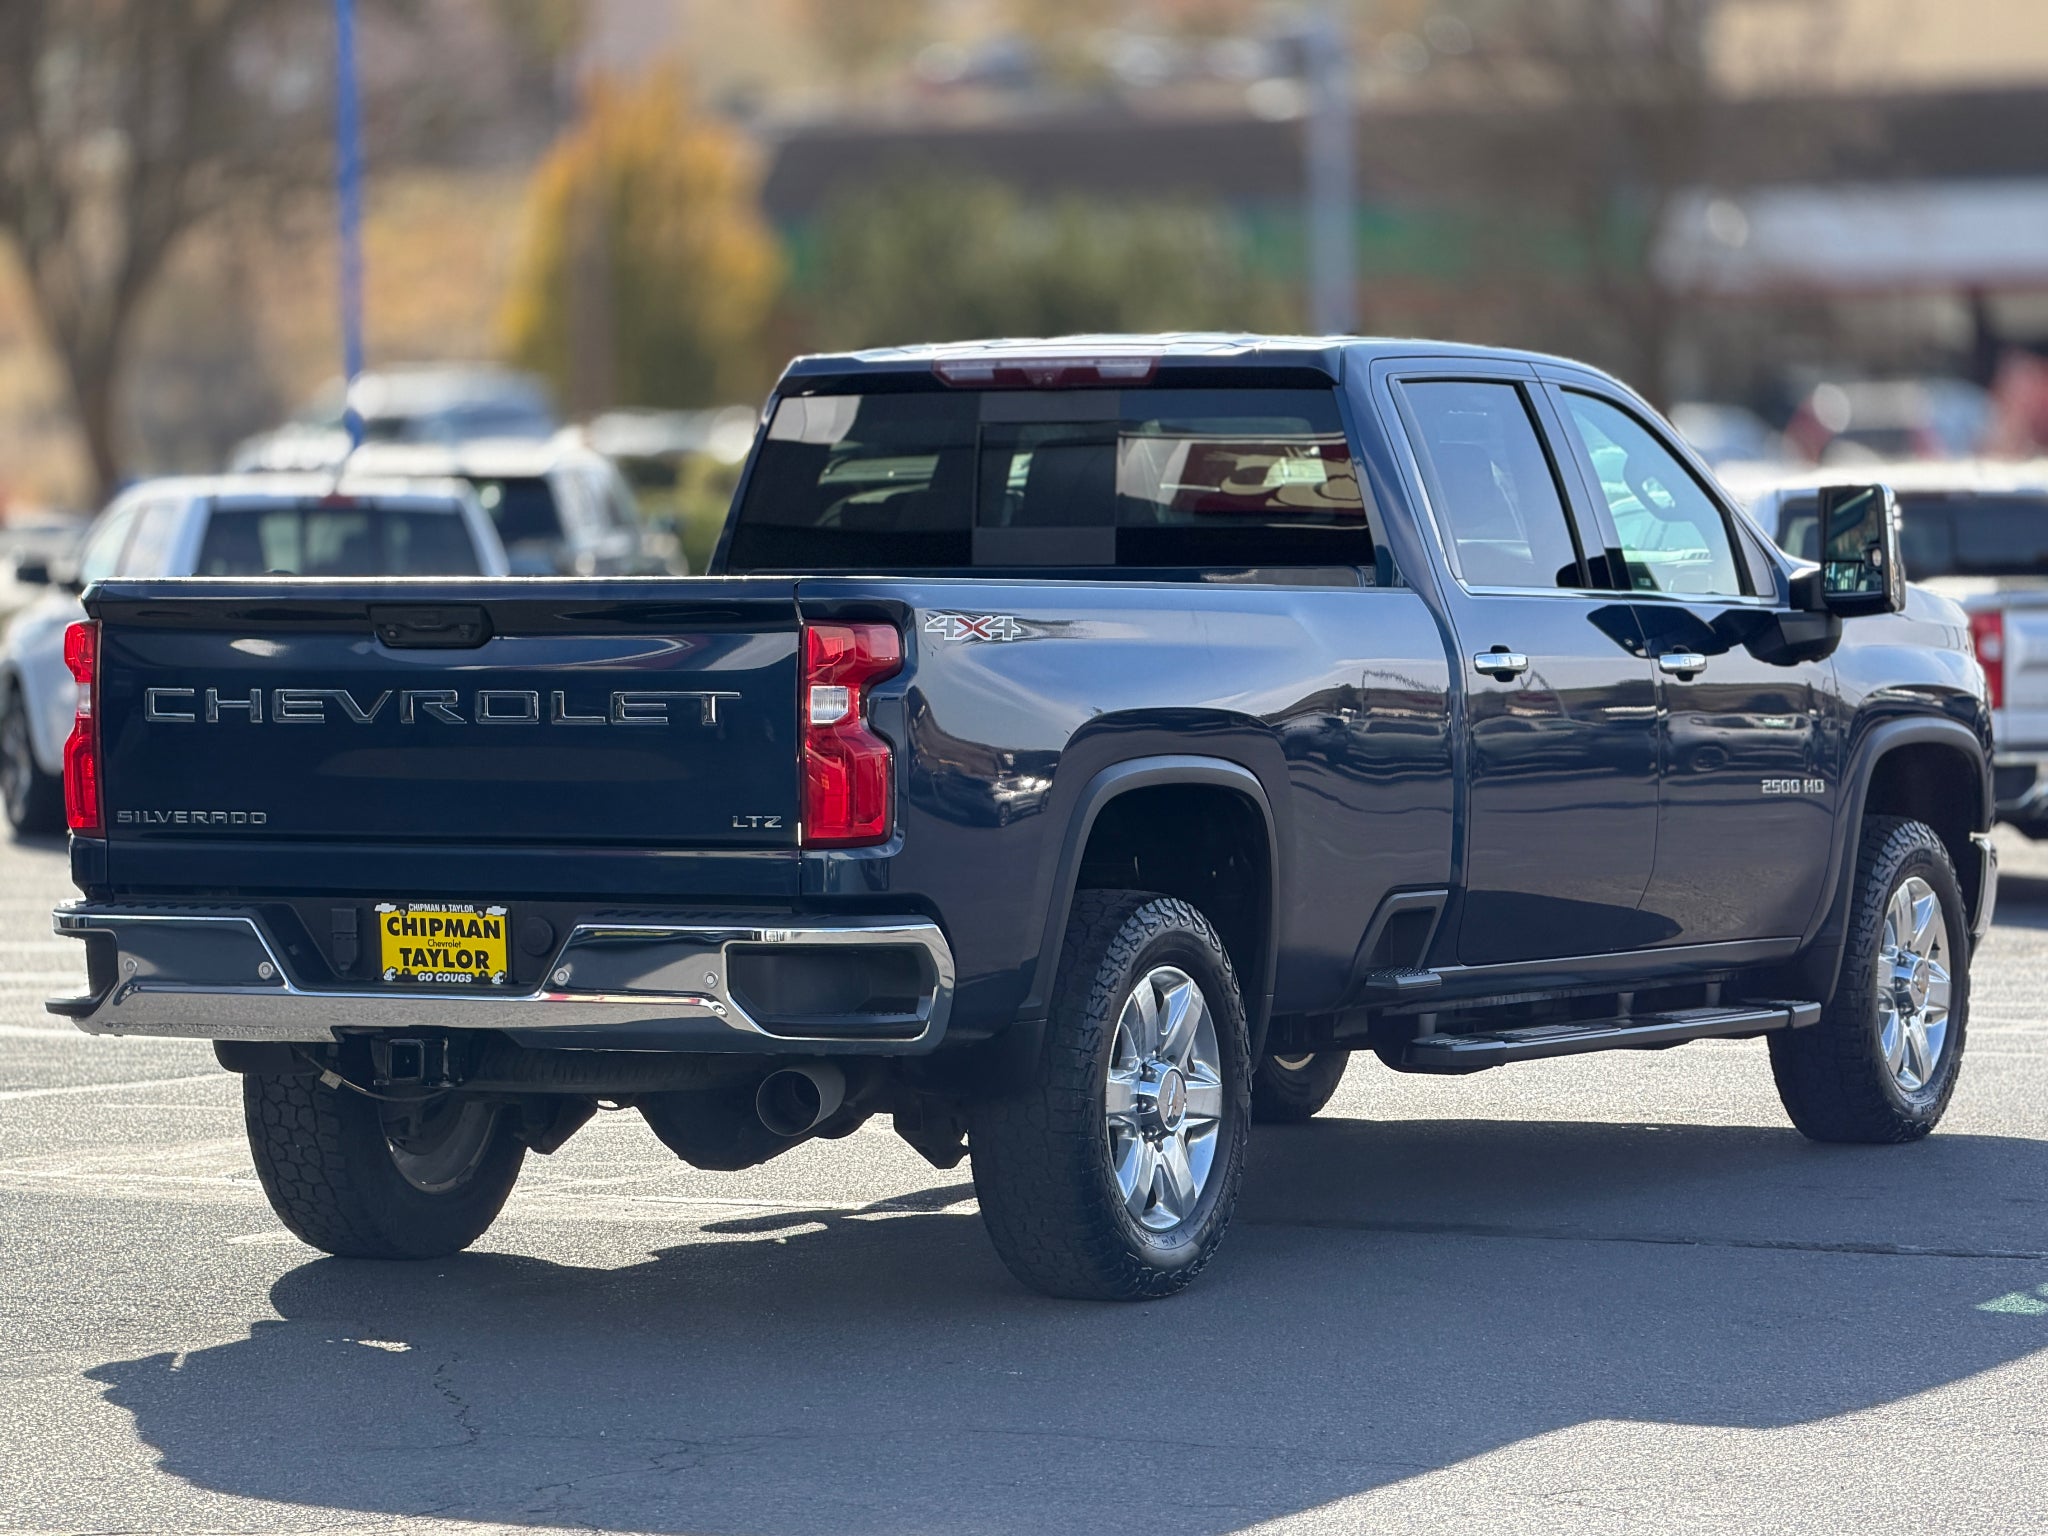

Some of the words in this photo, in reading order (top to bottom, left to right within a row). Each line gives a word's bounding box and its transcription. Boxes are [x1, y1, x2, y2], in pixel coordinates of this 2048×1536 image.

[145, 687, 742, 726] CHEVROLET
[1761, 779, 1800, 794] 2500
[1803, 779, 1825, 794] HD
[116, 810, 267, 825] SILVERADO
[732, 815, 782, 828] LTZ
[408, 903, 440, 913] CHIPMAN
[442, 904, 447, 913] &
[448, 904, 475, 914] TAYLOR
[386, 917, 501, 940] CHIPMAN
[427, 938, 462, 949] Chevrolet
[399, 947, 490, 970] TAYLOR
[417, 972, 434, 983] GO
[435, 972, 473, 984] COUGS
